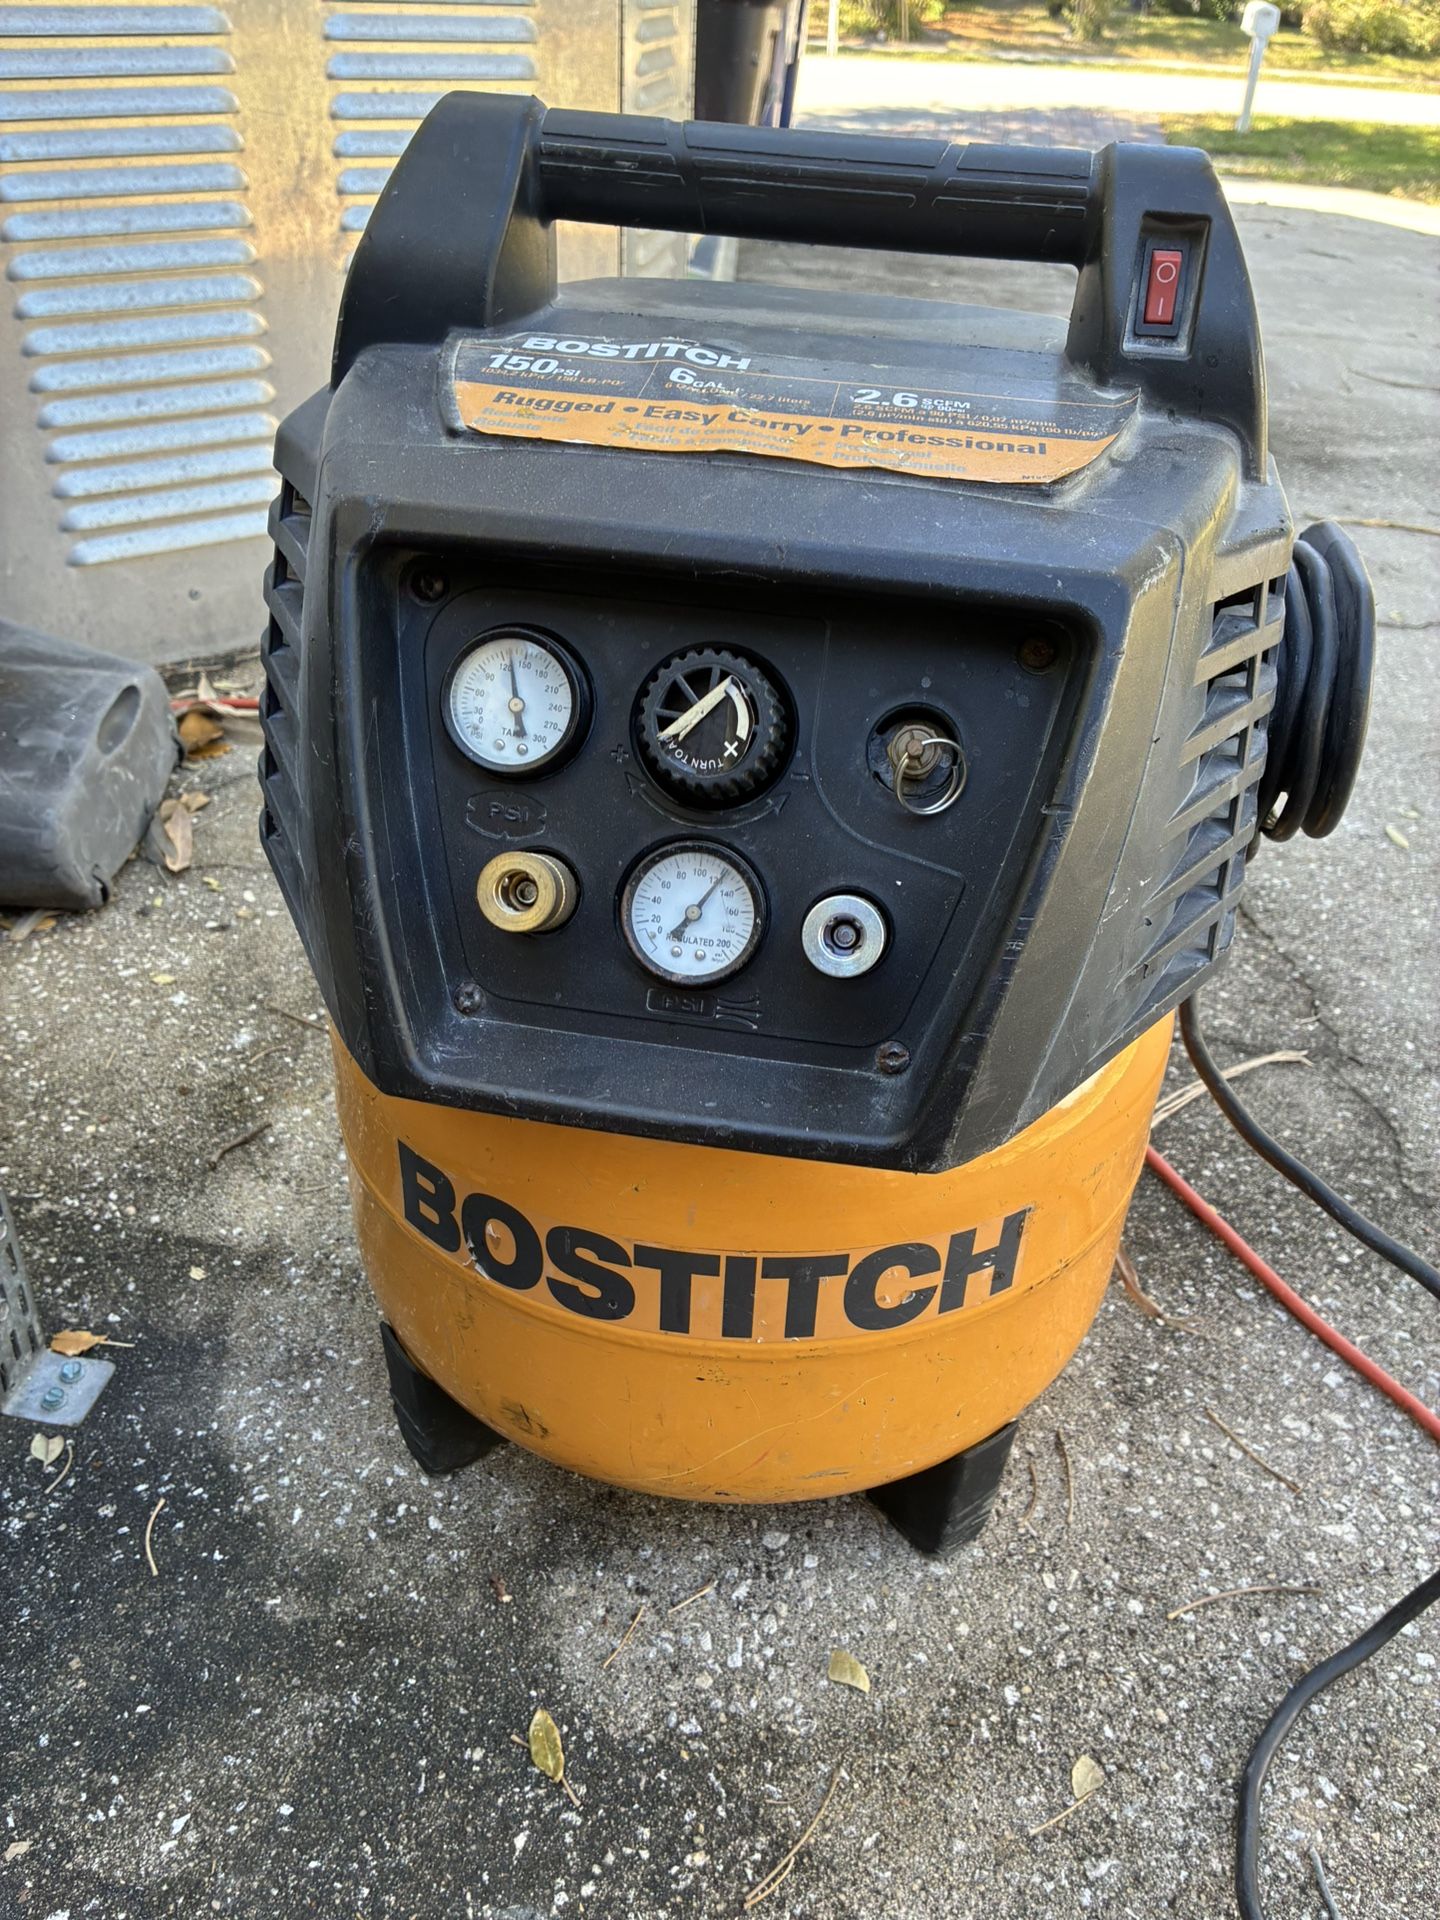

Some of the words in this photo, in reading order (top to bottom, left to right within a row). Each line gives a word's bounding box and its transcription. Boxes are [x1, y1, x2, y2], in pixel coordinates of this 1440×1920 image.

[521, 337, 751, 370] BOSTITCH
[854, 389, 919, 408] 2.6
[921, 398, 971, 409] SCFM
[492, 391, 615, 413] Rugged
[643, 405, 720, 426] Easy
[727, 409, 814, 436] Carry
[840, 424, 1047, 455] Professional
[518, 660, 532, 670] 150
[485, 672, 495, 682] 90
[535, 669, 549, 680] 180
[475, 688, 485, 698] 60
[544, 684, 560, 695] 210
[474, 705, 484, 715] 30
[548, 702, 563, 713] 240
[478, 715, 484, 725] 0
[543, 720, 558, 731] 270
[532, 733, 548, 745] 300
[674, 749, 689, 765] TO
[690, 757, 724, 770] TURN
[676, 870, 687, 881] 80
[693, 867, 708, 878] 100
[661, 881, 672, 890] 60
[720, 889, 735, 898] 140
[651, 895, 662, 905] 40
[651, 914, 662, 924] 20
[657, 925, 663, 935] 0
[716, 938, 731, 949] 200
[398, 1139, 1030, 1340] BOSTITCH
